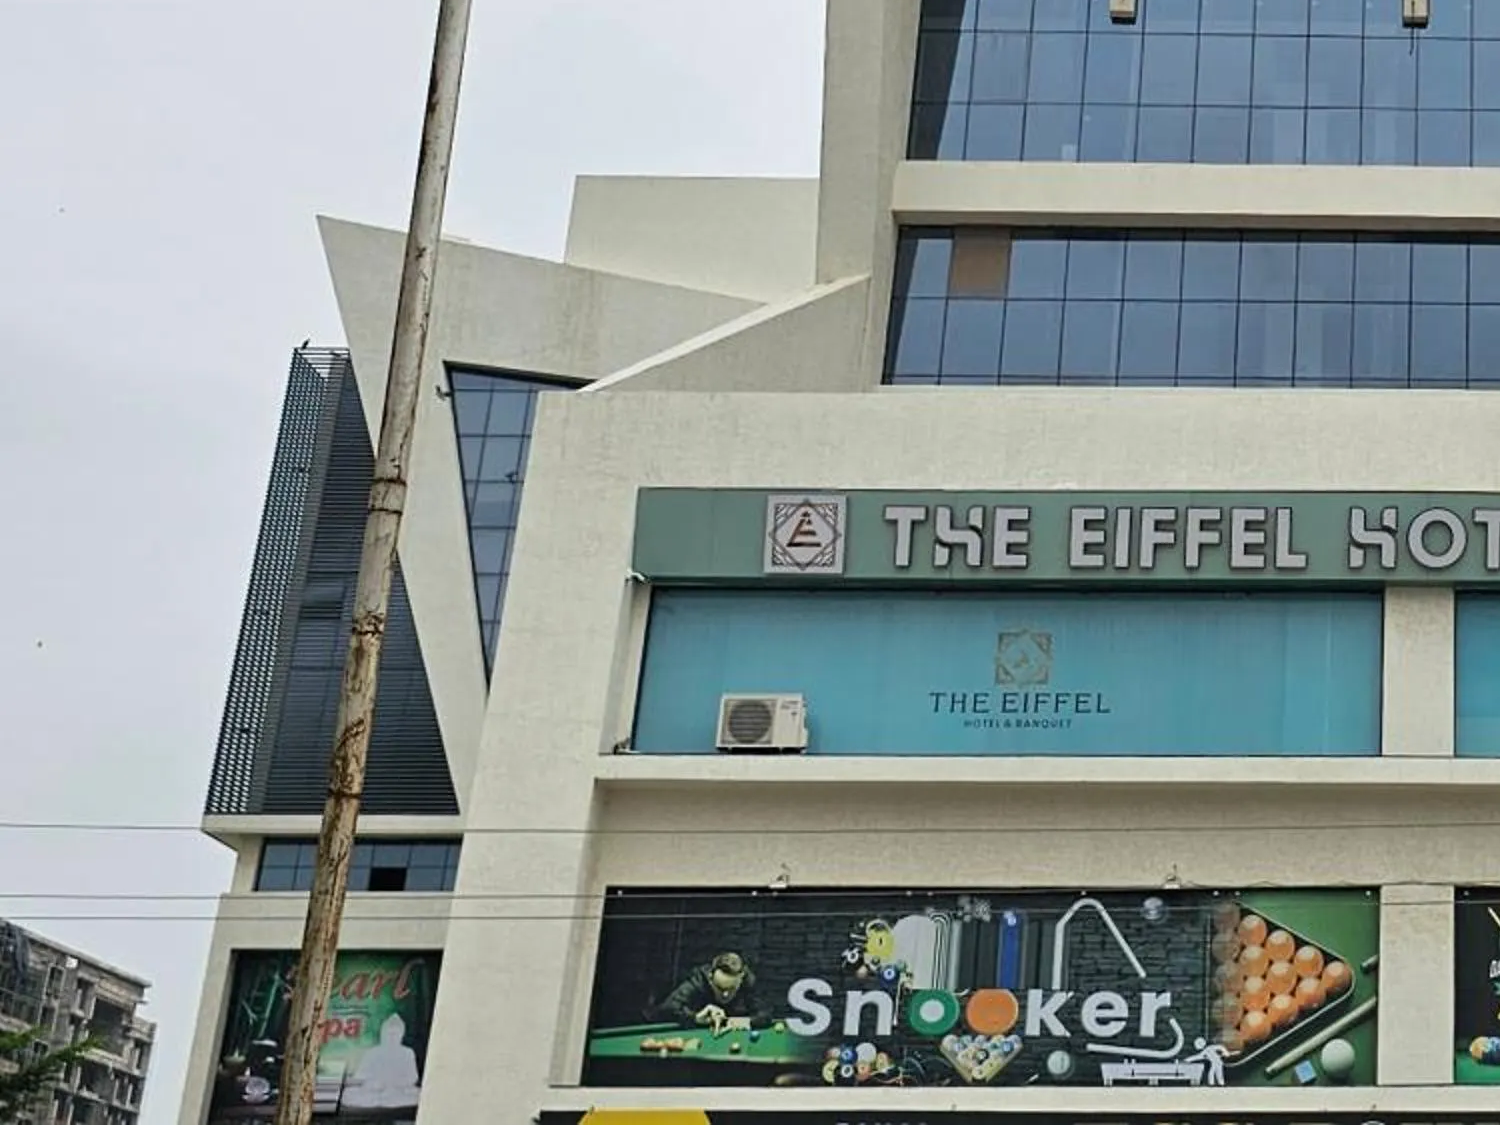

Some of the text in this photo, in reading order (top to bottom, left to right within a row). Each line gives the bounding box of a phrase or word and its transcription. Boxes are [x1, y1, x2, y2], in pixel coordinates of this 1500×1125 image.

[883, 505, 1031, 568] THE
[1069, 506, 1308, 570] EIFFEL
[929, 691, 1112, 715] THE EIFFEL
[787, 977, 1171, 1038] Snooker
